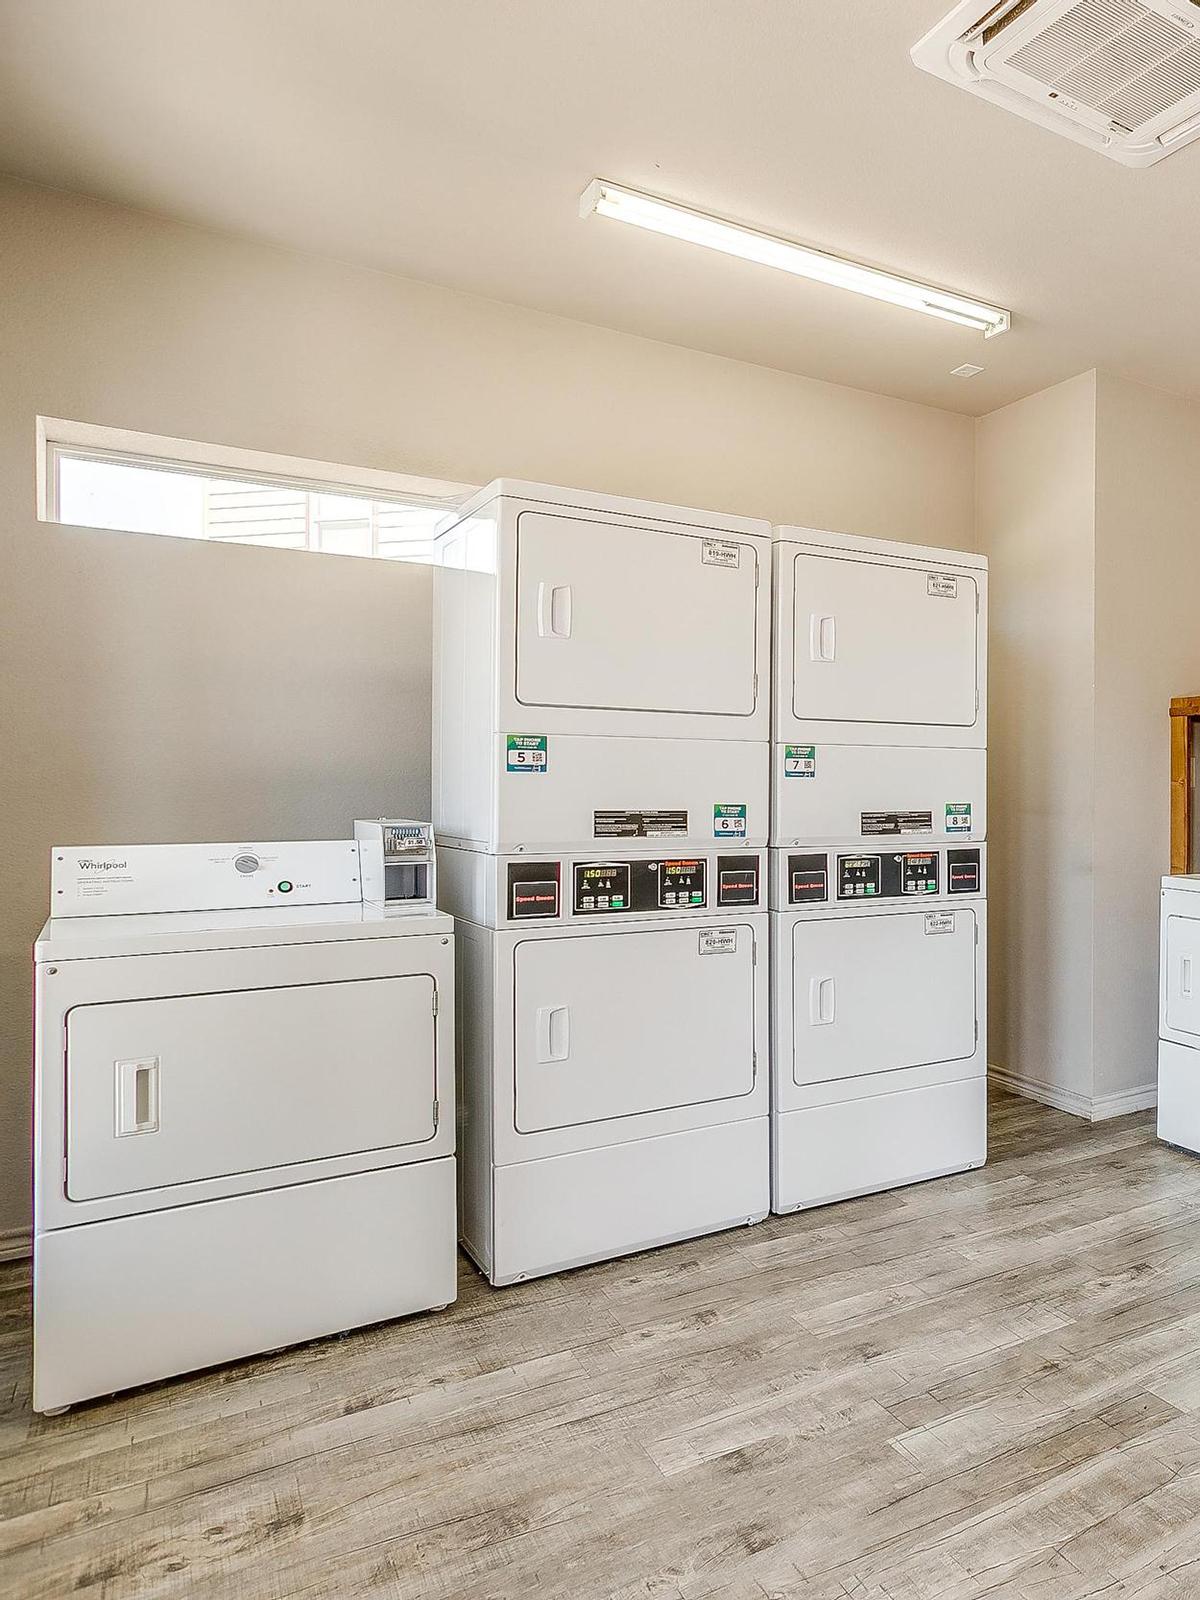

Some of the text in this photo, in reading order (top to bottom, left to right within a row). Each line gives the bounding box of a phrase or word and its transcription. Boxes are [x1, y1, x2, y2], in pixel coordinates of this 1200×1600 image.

[517, 752, 526, 763] 5
[721, 819, 729, 829] 6
[79, 860, 127, 870] Whirlpool
